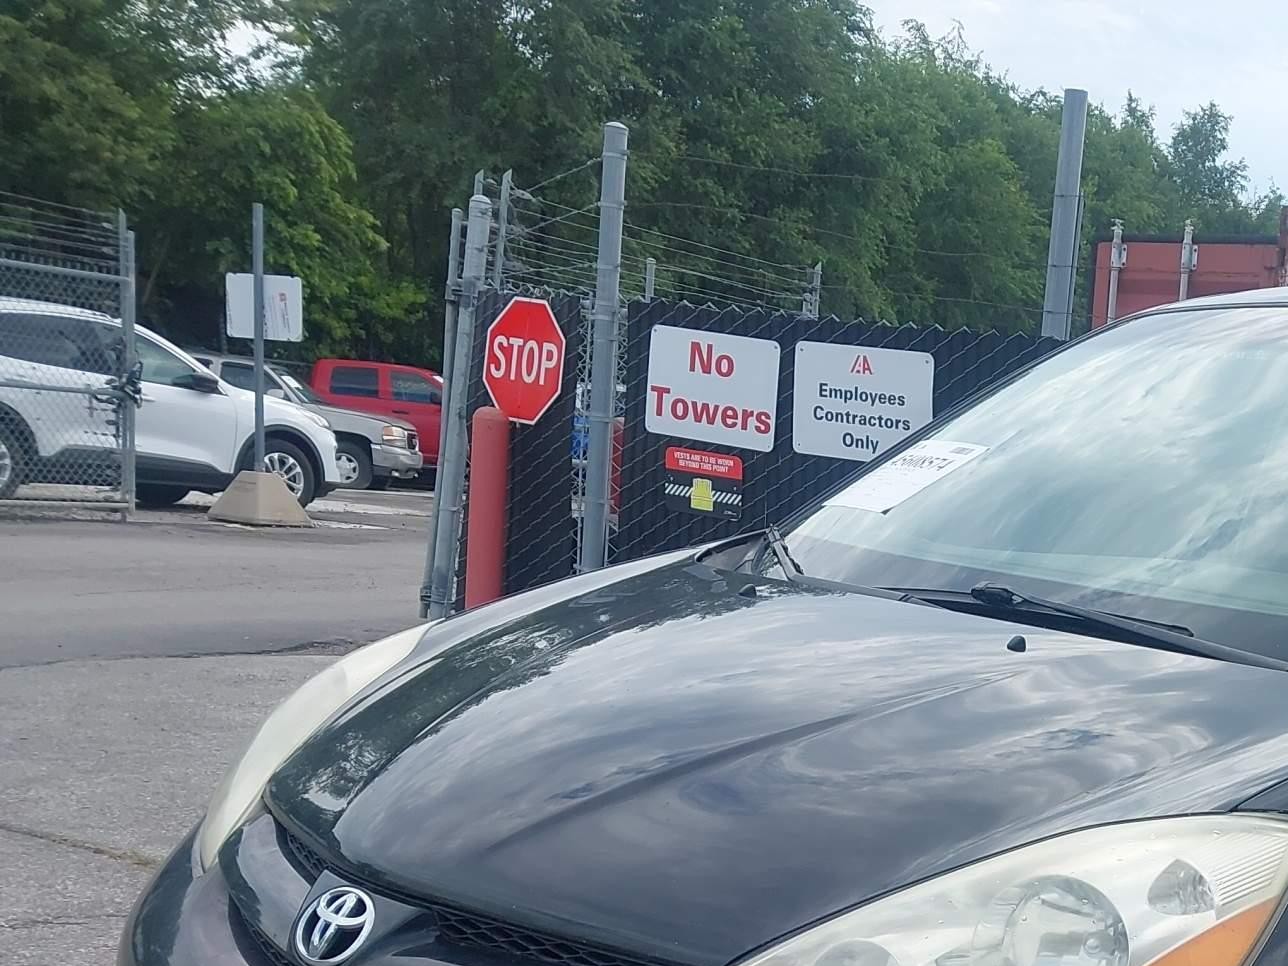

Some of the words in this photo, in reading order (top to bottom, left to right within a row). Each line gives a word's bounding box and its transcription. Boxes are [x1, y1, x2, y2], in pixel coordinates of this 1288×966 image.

[489, 335, 558, 386] STOP
[688, 341, 735, 378] No
[818, 382, 906, 407] Employees
[650, 384, 772, 435] Towers
[812, 405, 911, 431] Contractors
[673, 451, 690, 460] VESTS
[842, 432, 880, 454] Only
[678, 459, 700, 468] BEYOND
[700, 462, 712, 470] THIS
[712, 464, 729, 473] POINT
